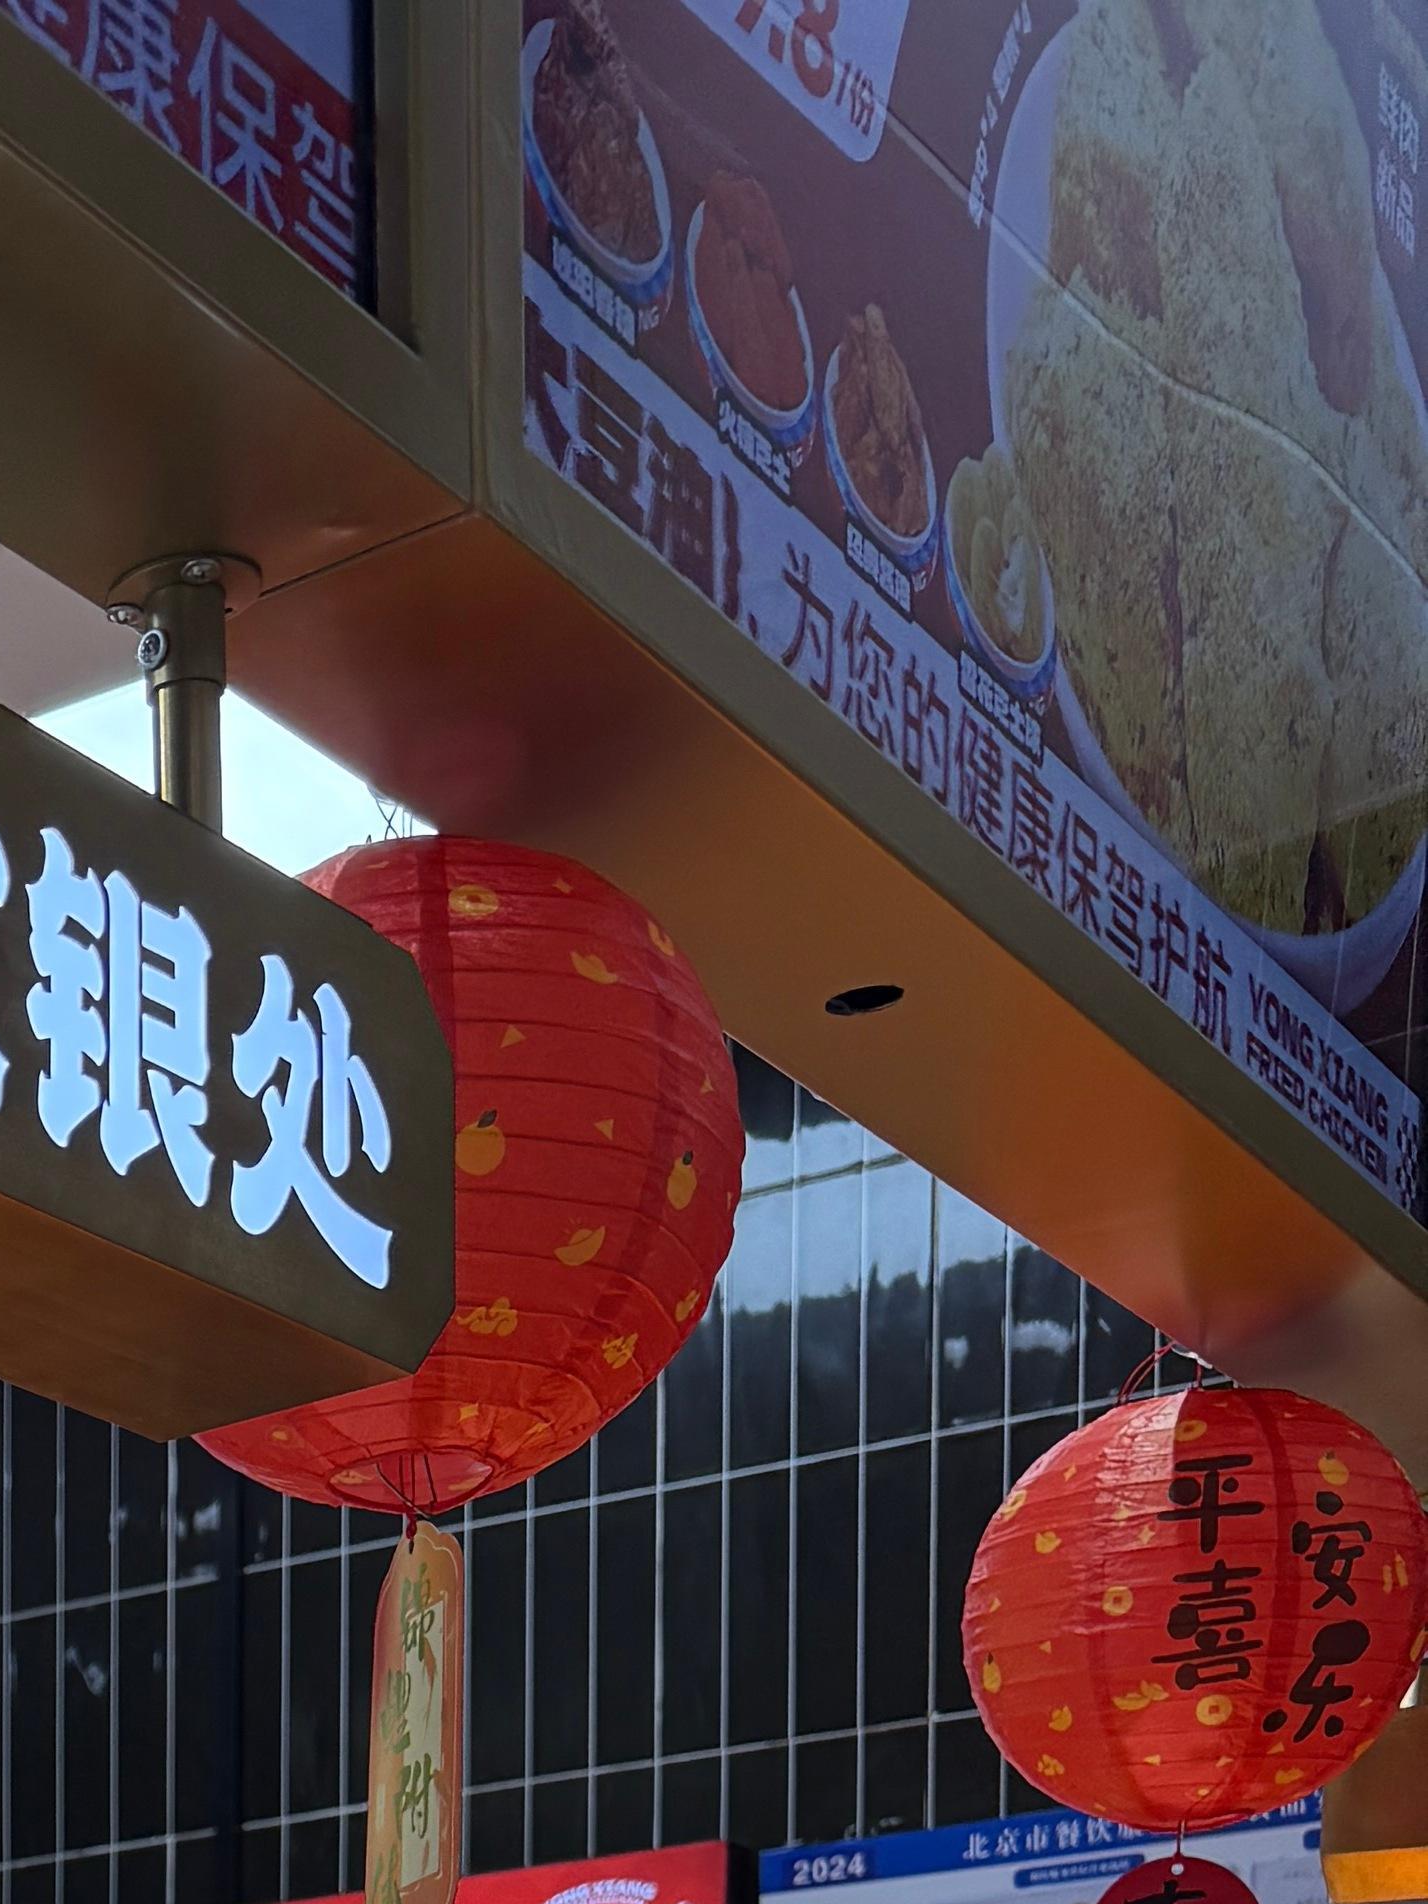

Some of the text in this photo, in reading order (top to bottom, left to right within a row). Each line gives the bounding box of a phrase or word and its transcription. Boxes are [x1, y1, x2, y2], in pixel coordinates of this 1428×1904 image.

[1248, 970, 1314, 1067] YONG
[1246, 1030, 1388, 1186] FRIED CHICKEN
[792, 1852, 866, 1886] 2024
